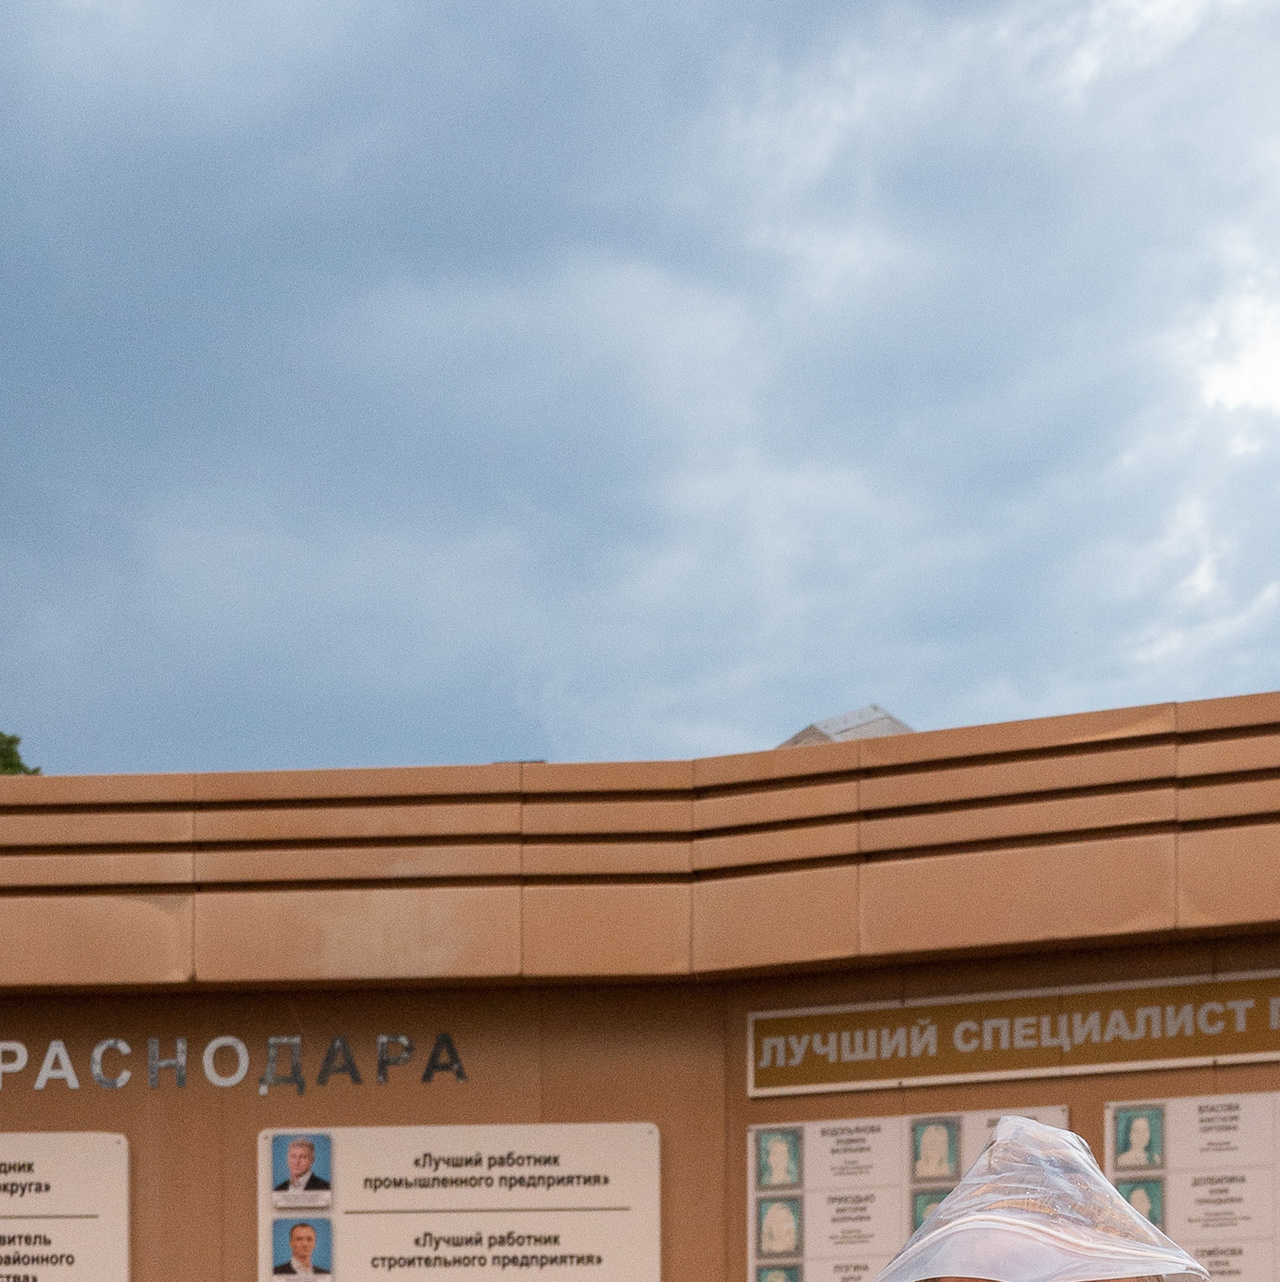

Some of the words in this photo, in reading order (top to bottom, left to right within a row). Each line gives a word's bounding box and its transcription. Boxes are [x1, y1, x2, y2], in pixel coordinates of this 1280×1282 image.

[759, 1019, 938, 1069] ЛУЧШИЙ
[953, 1000, 1255, 1053] СПЕЦИАЛИСТ
[414, 1152, 482, 1171] «Лучший
[488, 1152, 560, 1170] работник
[0, 1182, 51, 1196] круга»
[363, 1177, 494, 1191] промышленного
[499, 1174, 609, 1190] предприятия»
[414, 1232, 482, 1250] «Лучший
[488, 1231, 560, 1249] работник
[371, 1254, 487, 1271] строительного
[491, 1253, 602, 1270] предприятия»
